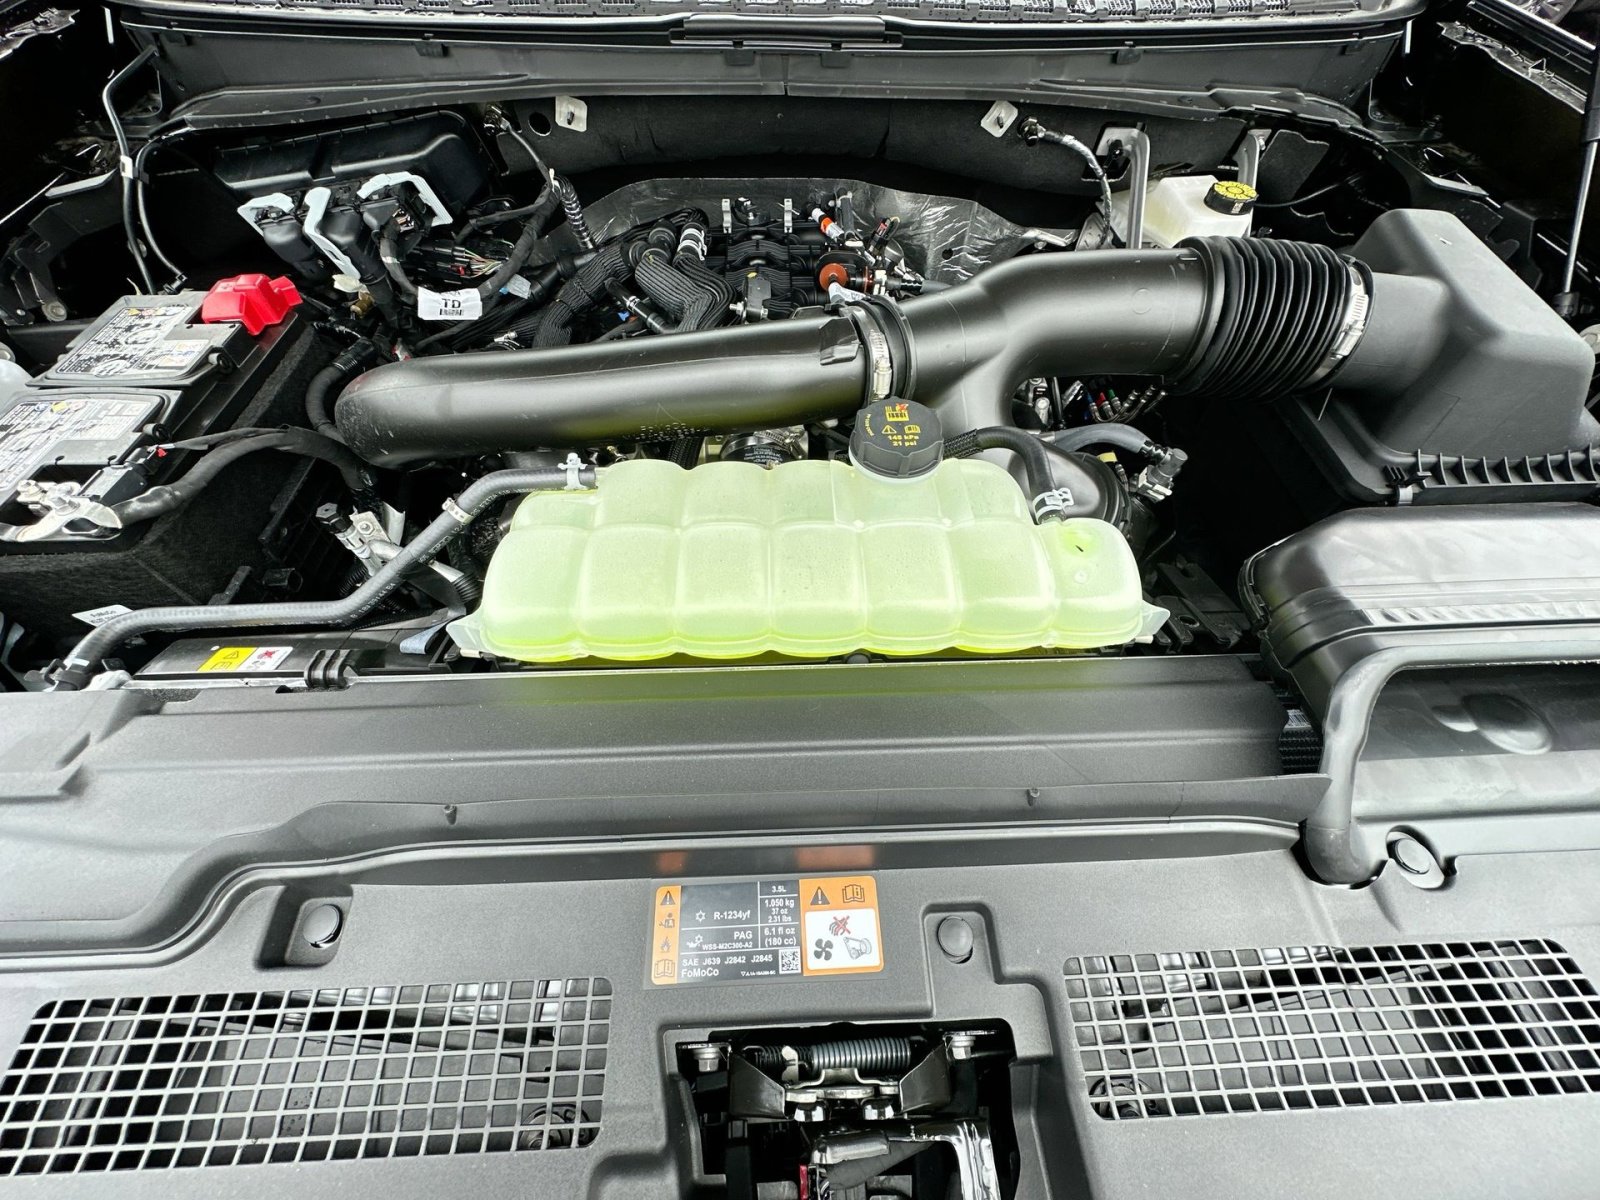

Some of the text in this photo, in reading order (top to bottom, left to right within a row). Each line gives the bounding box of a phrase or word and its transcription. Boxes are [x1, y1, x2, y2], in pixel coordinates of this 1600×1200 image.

[442, 298, 462, 309] TD
[771, 885, 787, 893] 3.5L
[764, 898, 795, 909] 1.050 kg
[713, 910, 751, 921] R-1234yf
[768, 915, 781, 923] 2.31
[733, 931, 753, 940] PAG
[764, 927, 776, 936] 6.1
[778, 926, 784, 935] fl
[702, 941, 753, 951] WSS-M2C300-A2
[764, 936, 797, 948] (180 cc)
[682, 954, 773, 967] SAE J639 J2842 J2845
[681, 967, 719, 978] FoMoCo
